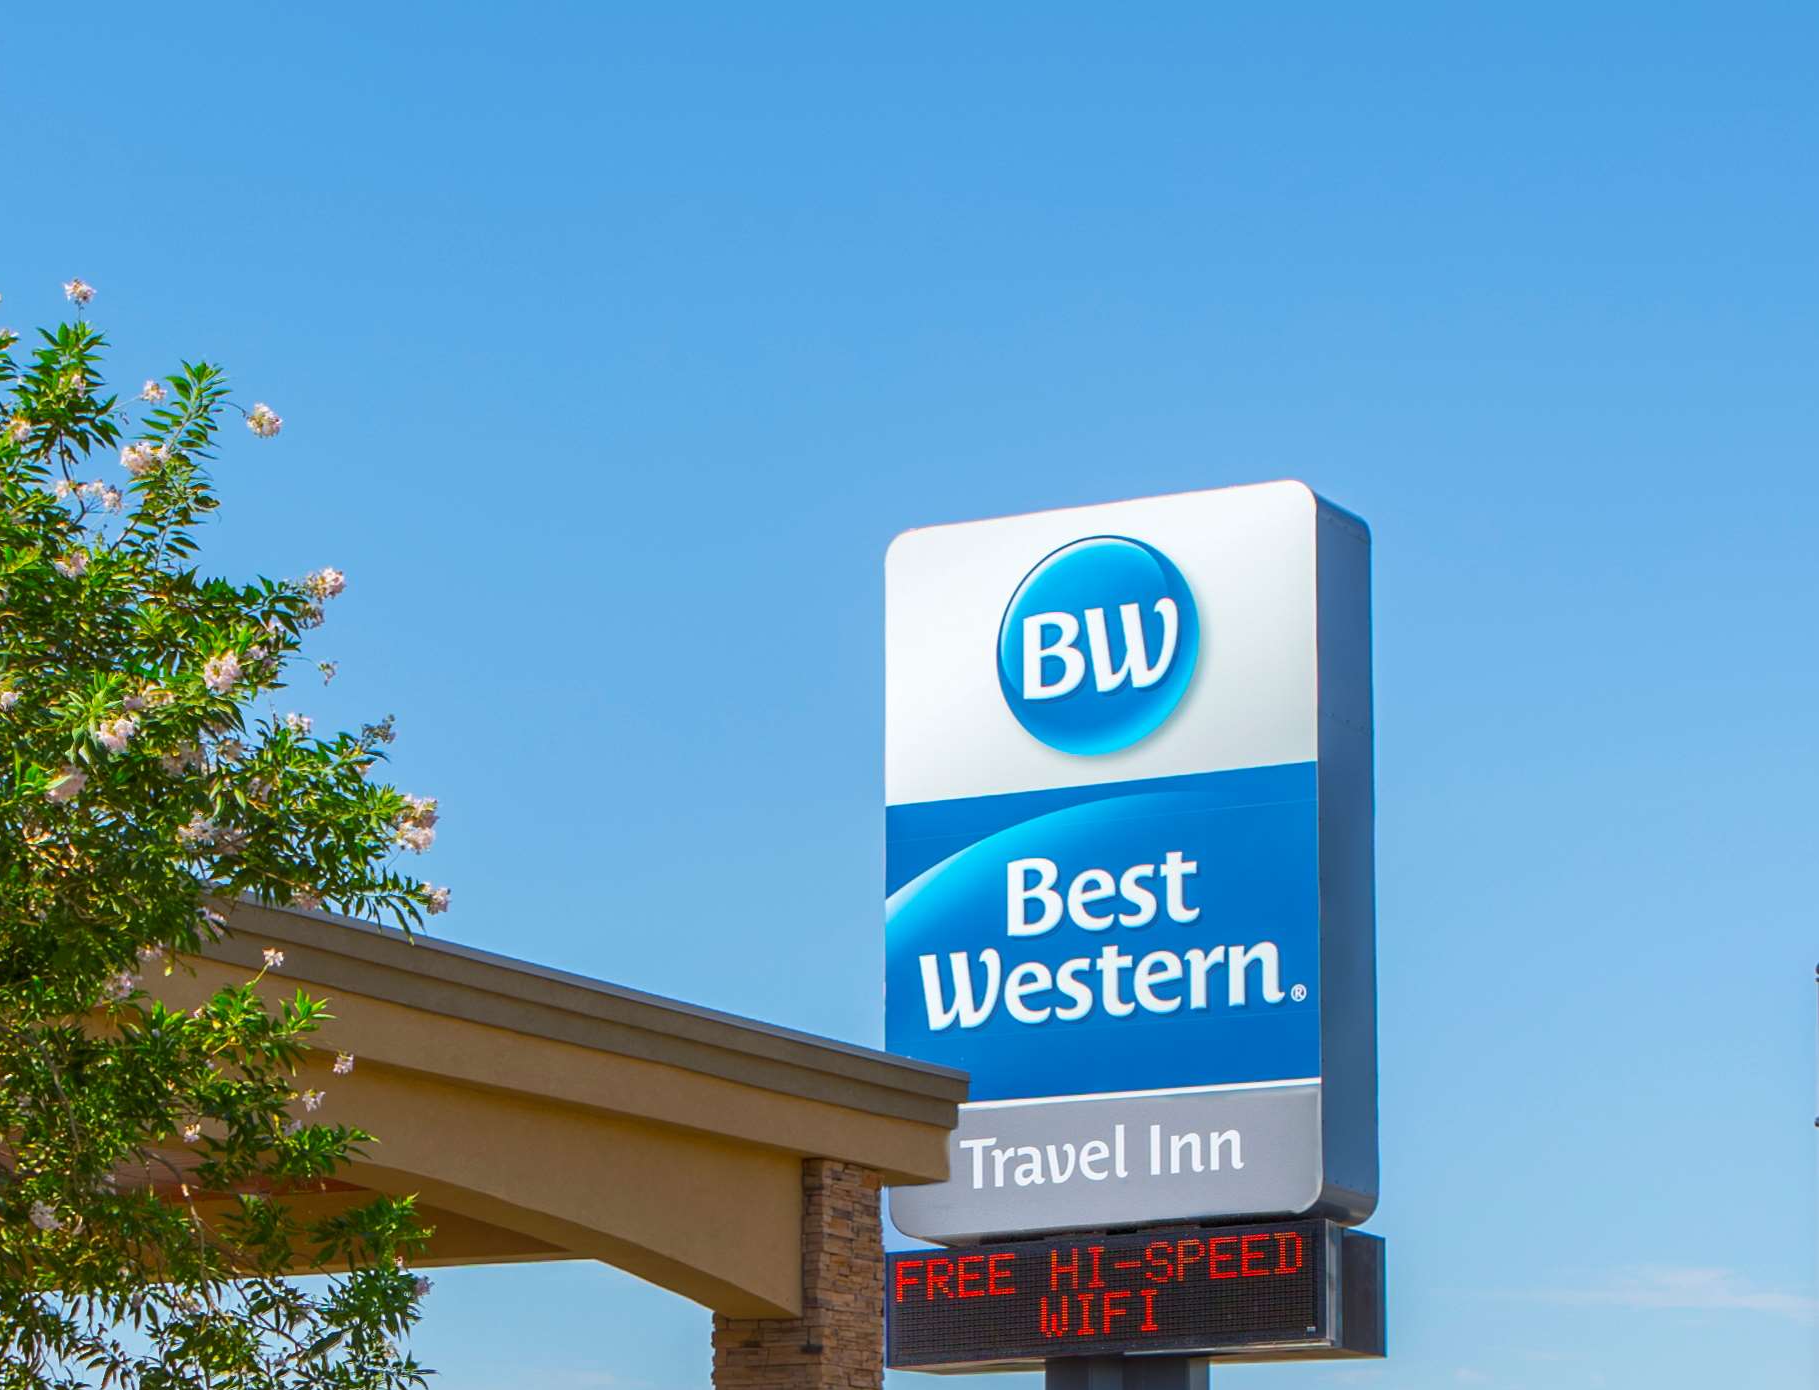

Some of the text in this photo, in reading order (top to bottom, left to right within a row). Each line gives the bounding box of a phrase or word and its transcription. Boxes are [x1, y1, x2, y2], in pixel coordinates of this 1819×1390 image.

[1022, 597, 1179, 701] BW
[1006, 850, 1201, 937] Best
[959, 1122, 1246, 1191] Travel Inn
[894, 1230, 1304, 1304] FREE HI-SPEED
[1039, 1288, 1160, 1339] WIFI
